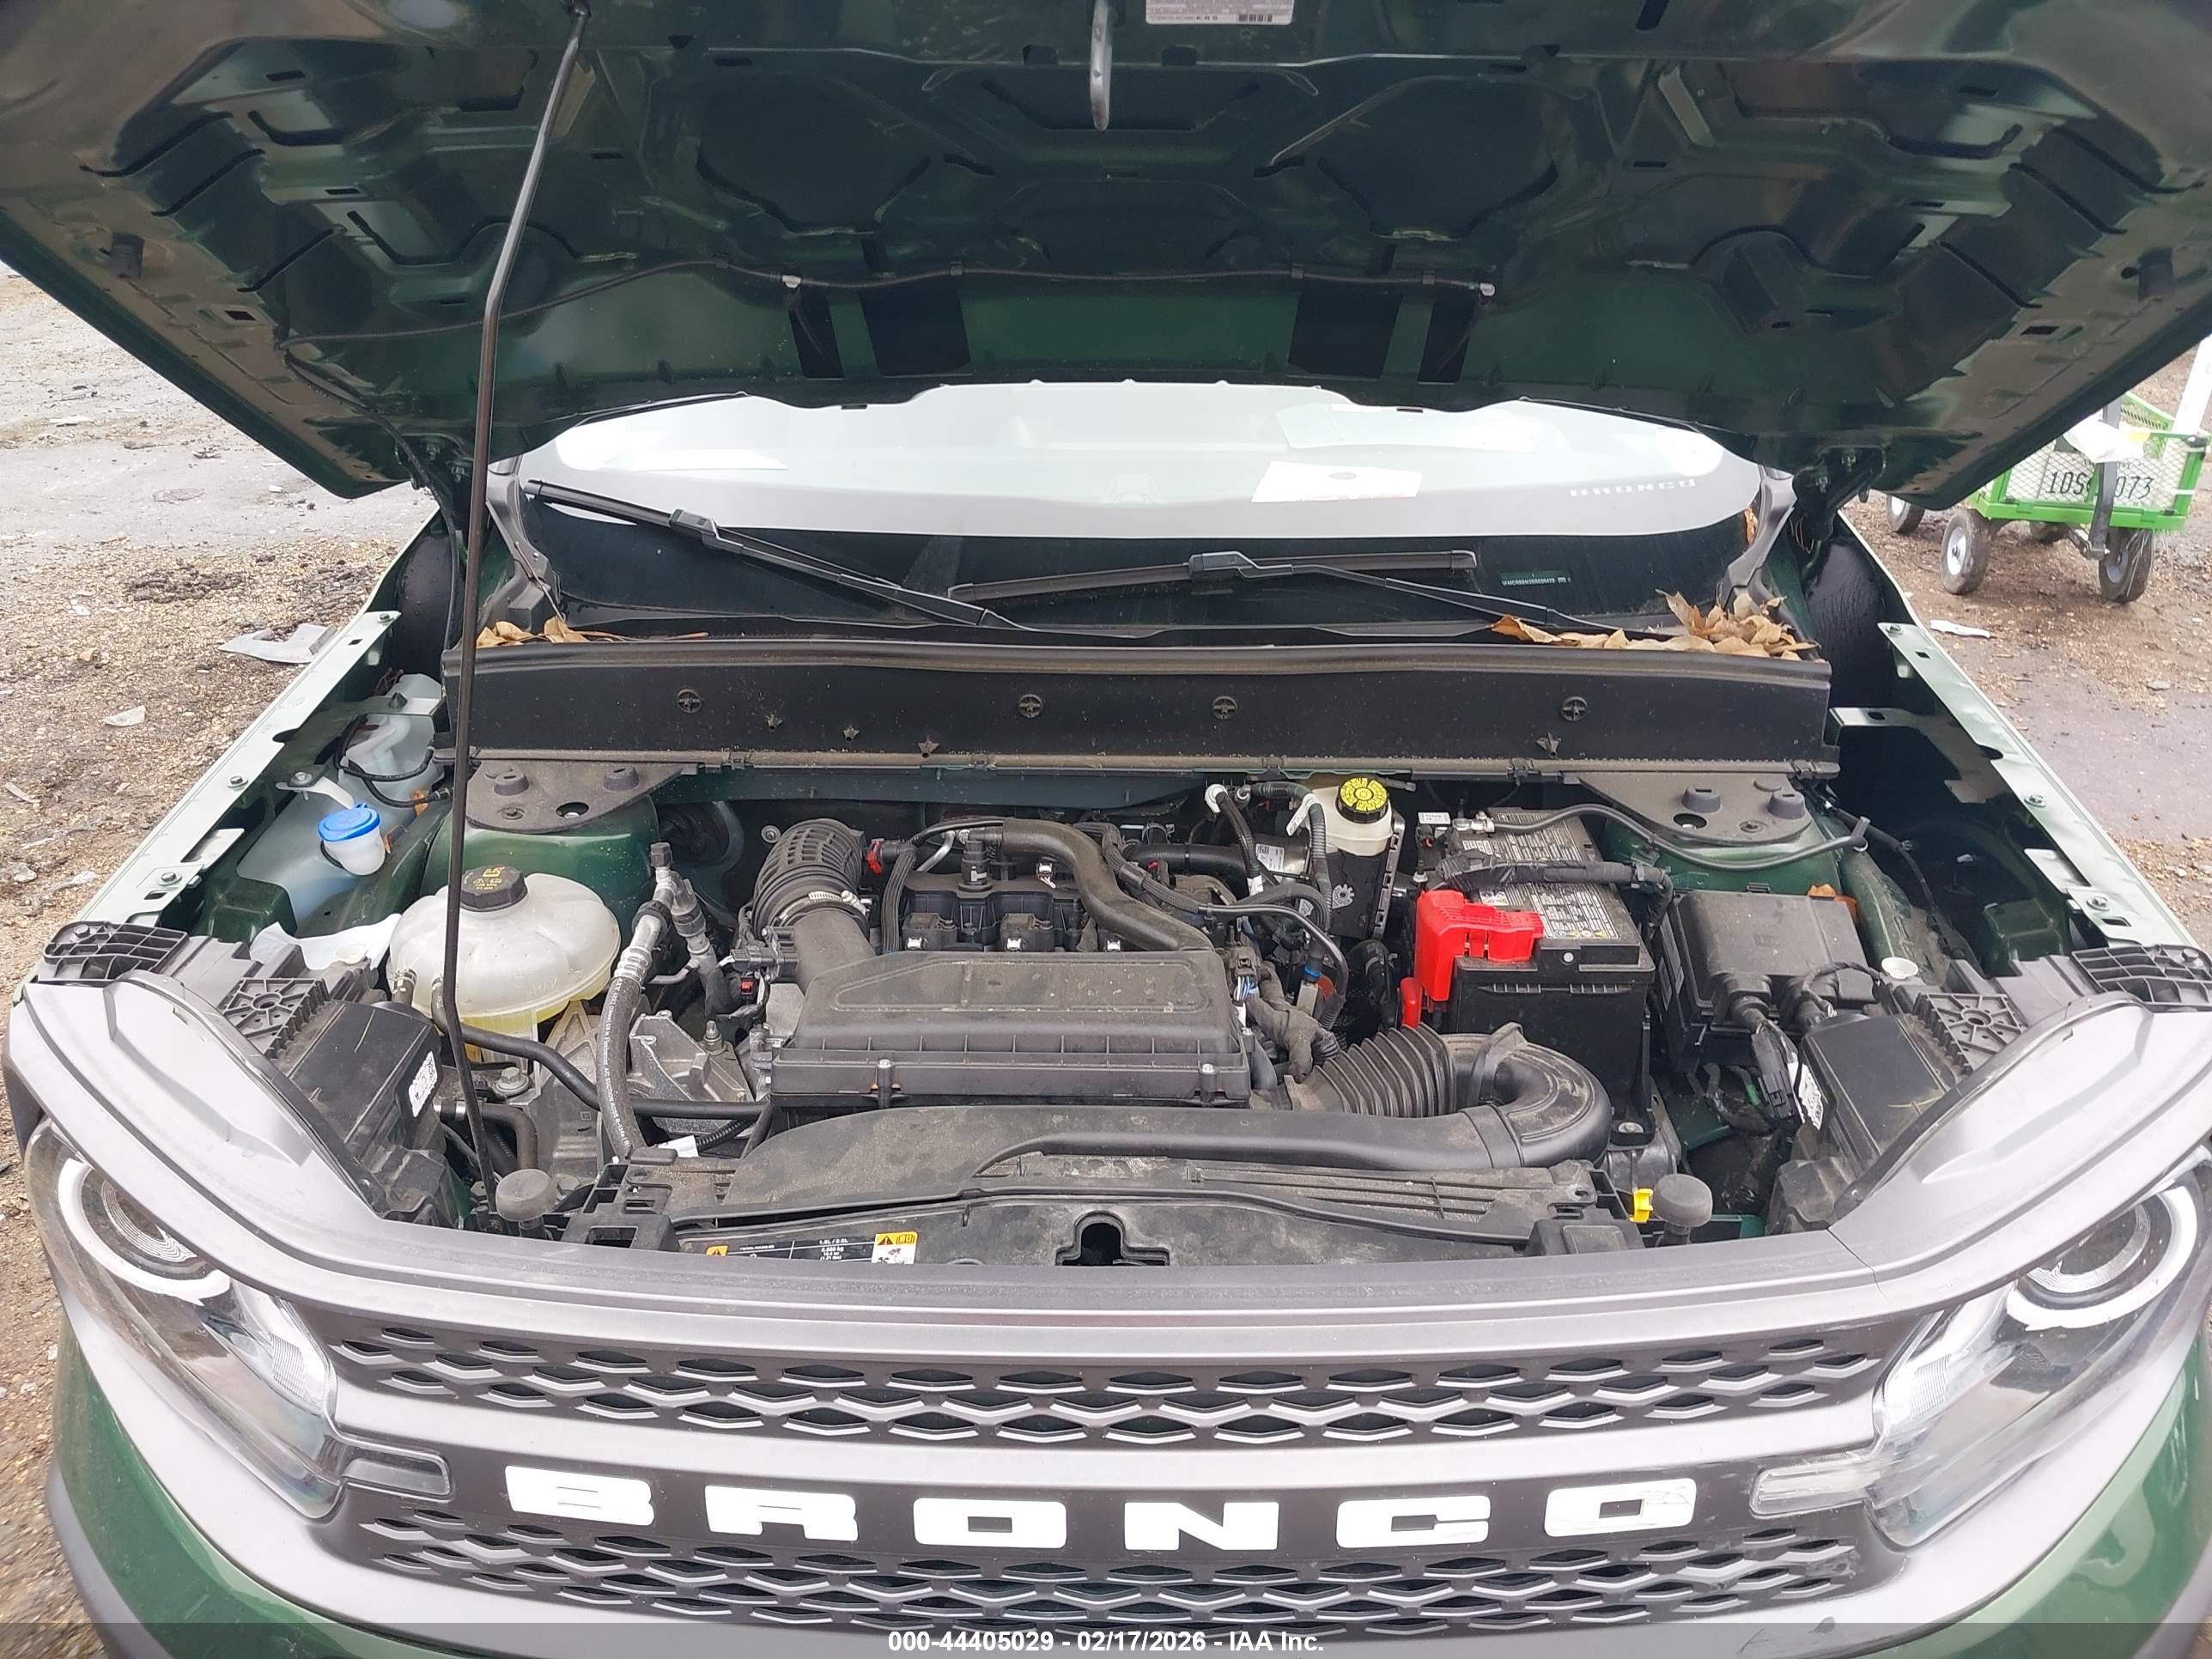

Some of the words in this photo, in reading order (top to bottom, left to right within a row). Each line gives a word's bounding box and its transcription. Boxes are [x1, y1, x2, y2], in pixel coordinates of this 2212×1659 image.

[605, 1077, 615, 1102] SUCTION
[611, 1102, 619, 1118] HOSE
[506, 1466, 1697, 1551] BRONCO
